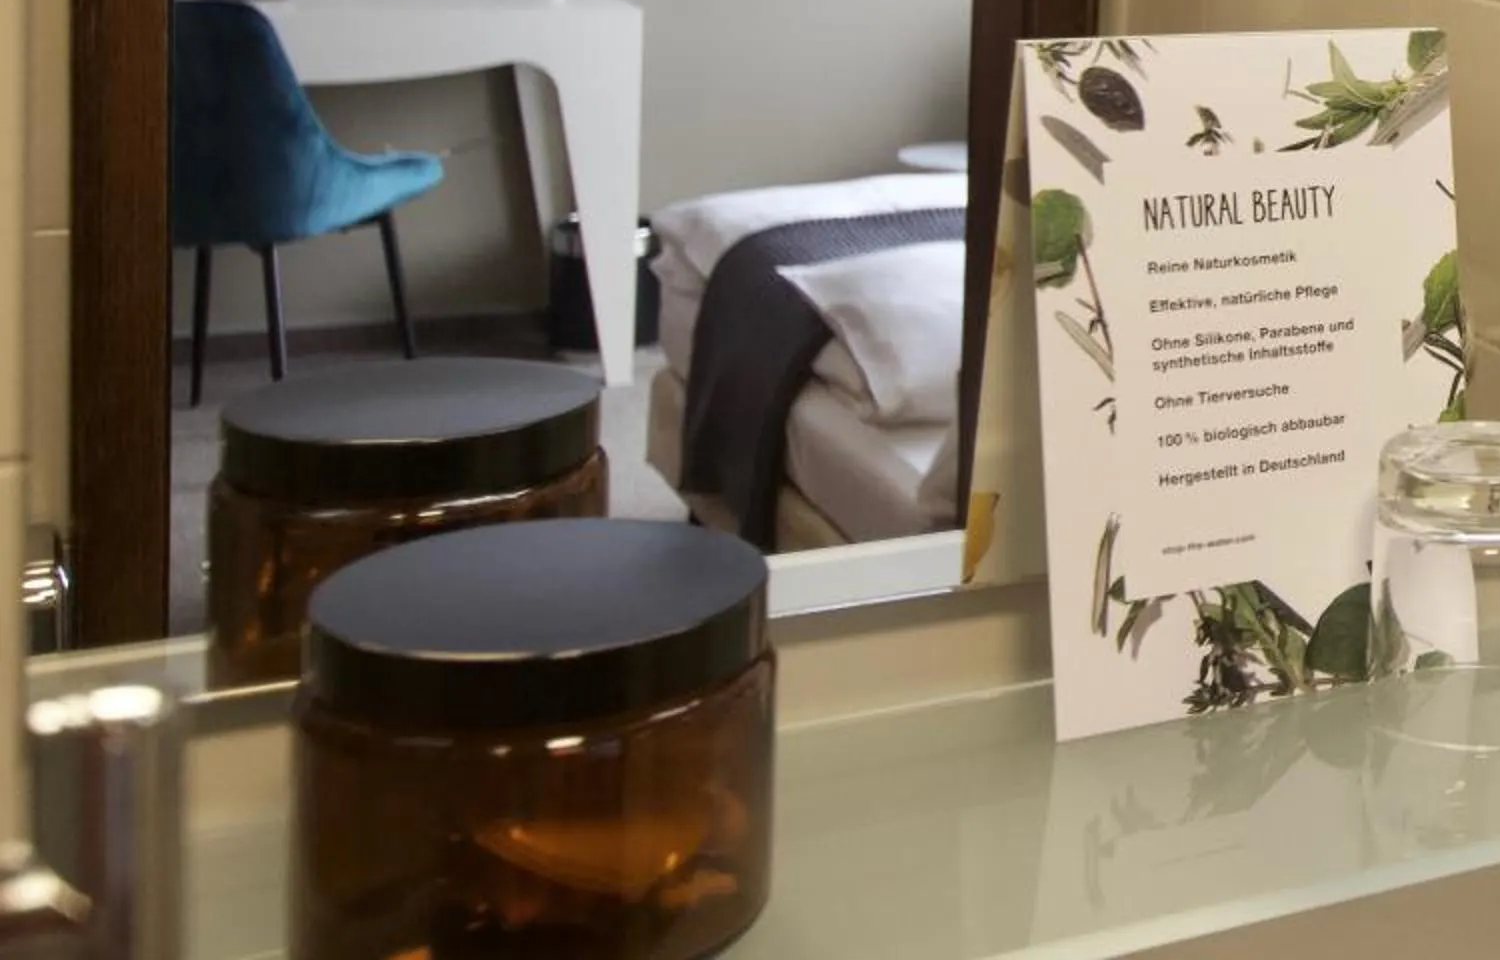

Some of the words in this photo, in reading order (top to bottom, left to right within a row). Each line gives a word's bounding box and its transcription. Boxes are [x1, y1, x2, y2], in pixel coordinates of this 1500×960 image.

[1143, 191, 1244, 232] NATURAL
[1252, 185, 1335, 223] BEAUTY
[1147, 260, 1189, 275] Reine
[1193, 249, 1297, 271] Naturkosmetik
[1150, 297, 1217, 314] Effektive,
[1221, 288, 1291, 307] natürliche
[1295, 284, 1339, 300] Pflege
[1152, 336, 1190, 352] Ohne
[1194, 329, 1256, 348] Silikone,
[1259, 322, 1325, 341] Parabene
[1329, 317, 1355, 332] und
[1152, 350, 1245, 374] synthetische
[1249, 339, 1335, 361] Inhaltsstoffe
[1154, 395, 1194, 410] Ohne
[1198, 383, 1290, 405] Tierversuche
[1158, 432, 1183, 448] 100
[1185, 431, 1199, 445] %
[1203, 420, 1278, 442] biologisch
[1281, 413, 1346, 433] abbaubar
[1159, 462, 1239, 488] Hergestellt
[1241, 463, 1255, 476] in
[1259, 450, 1346, 474] Deutschland
